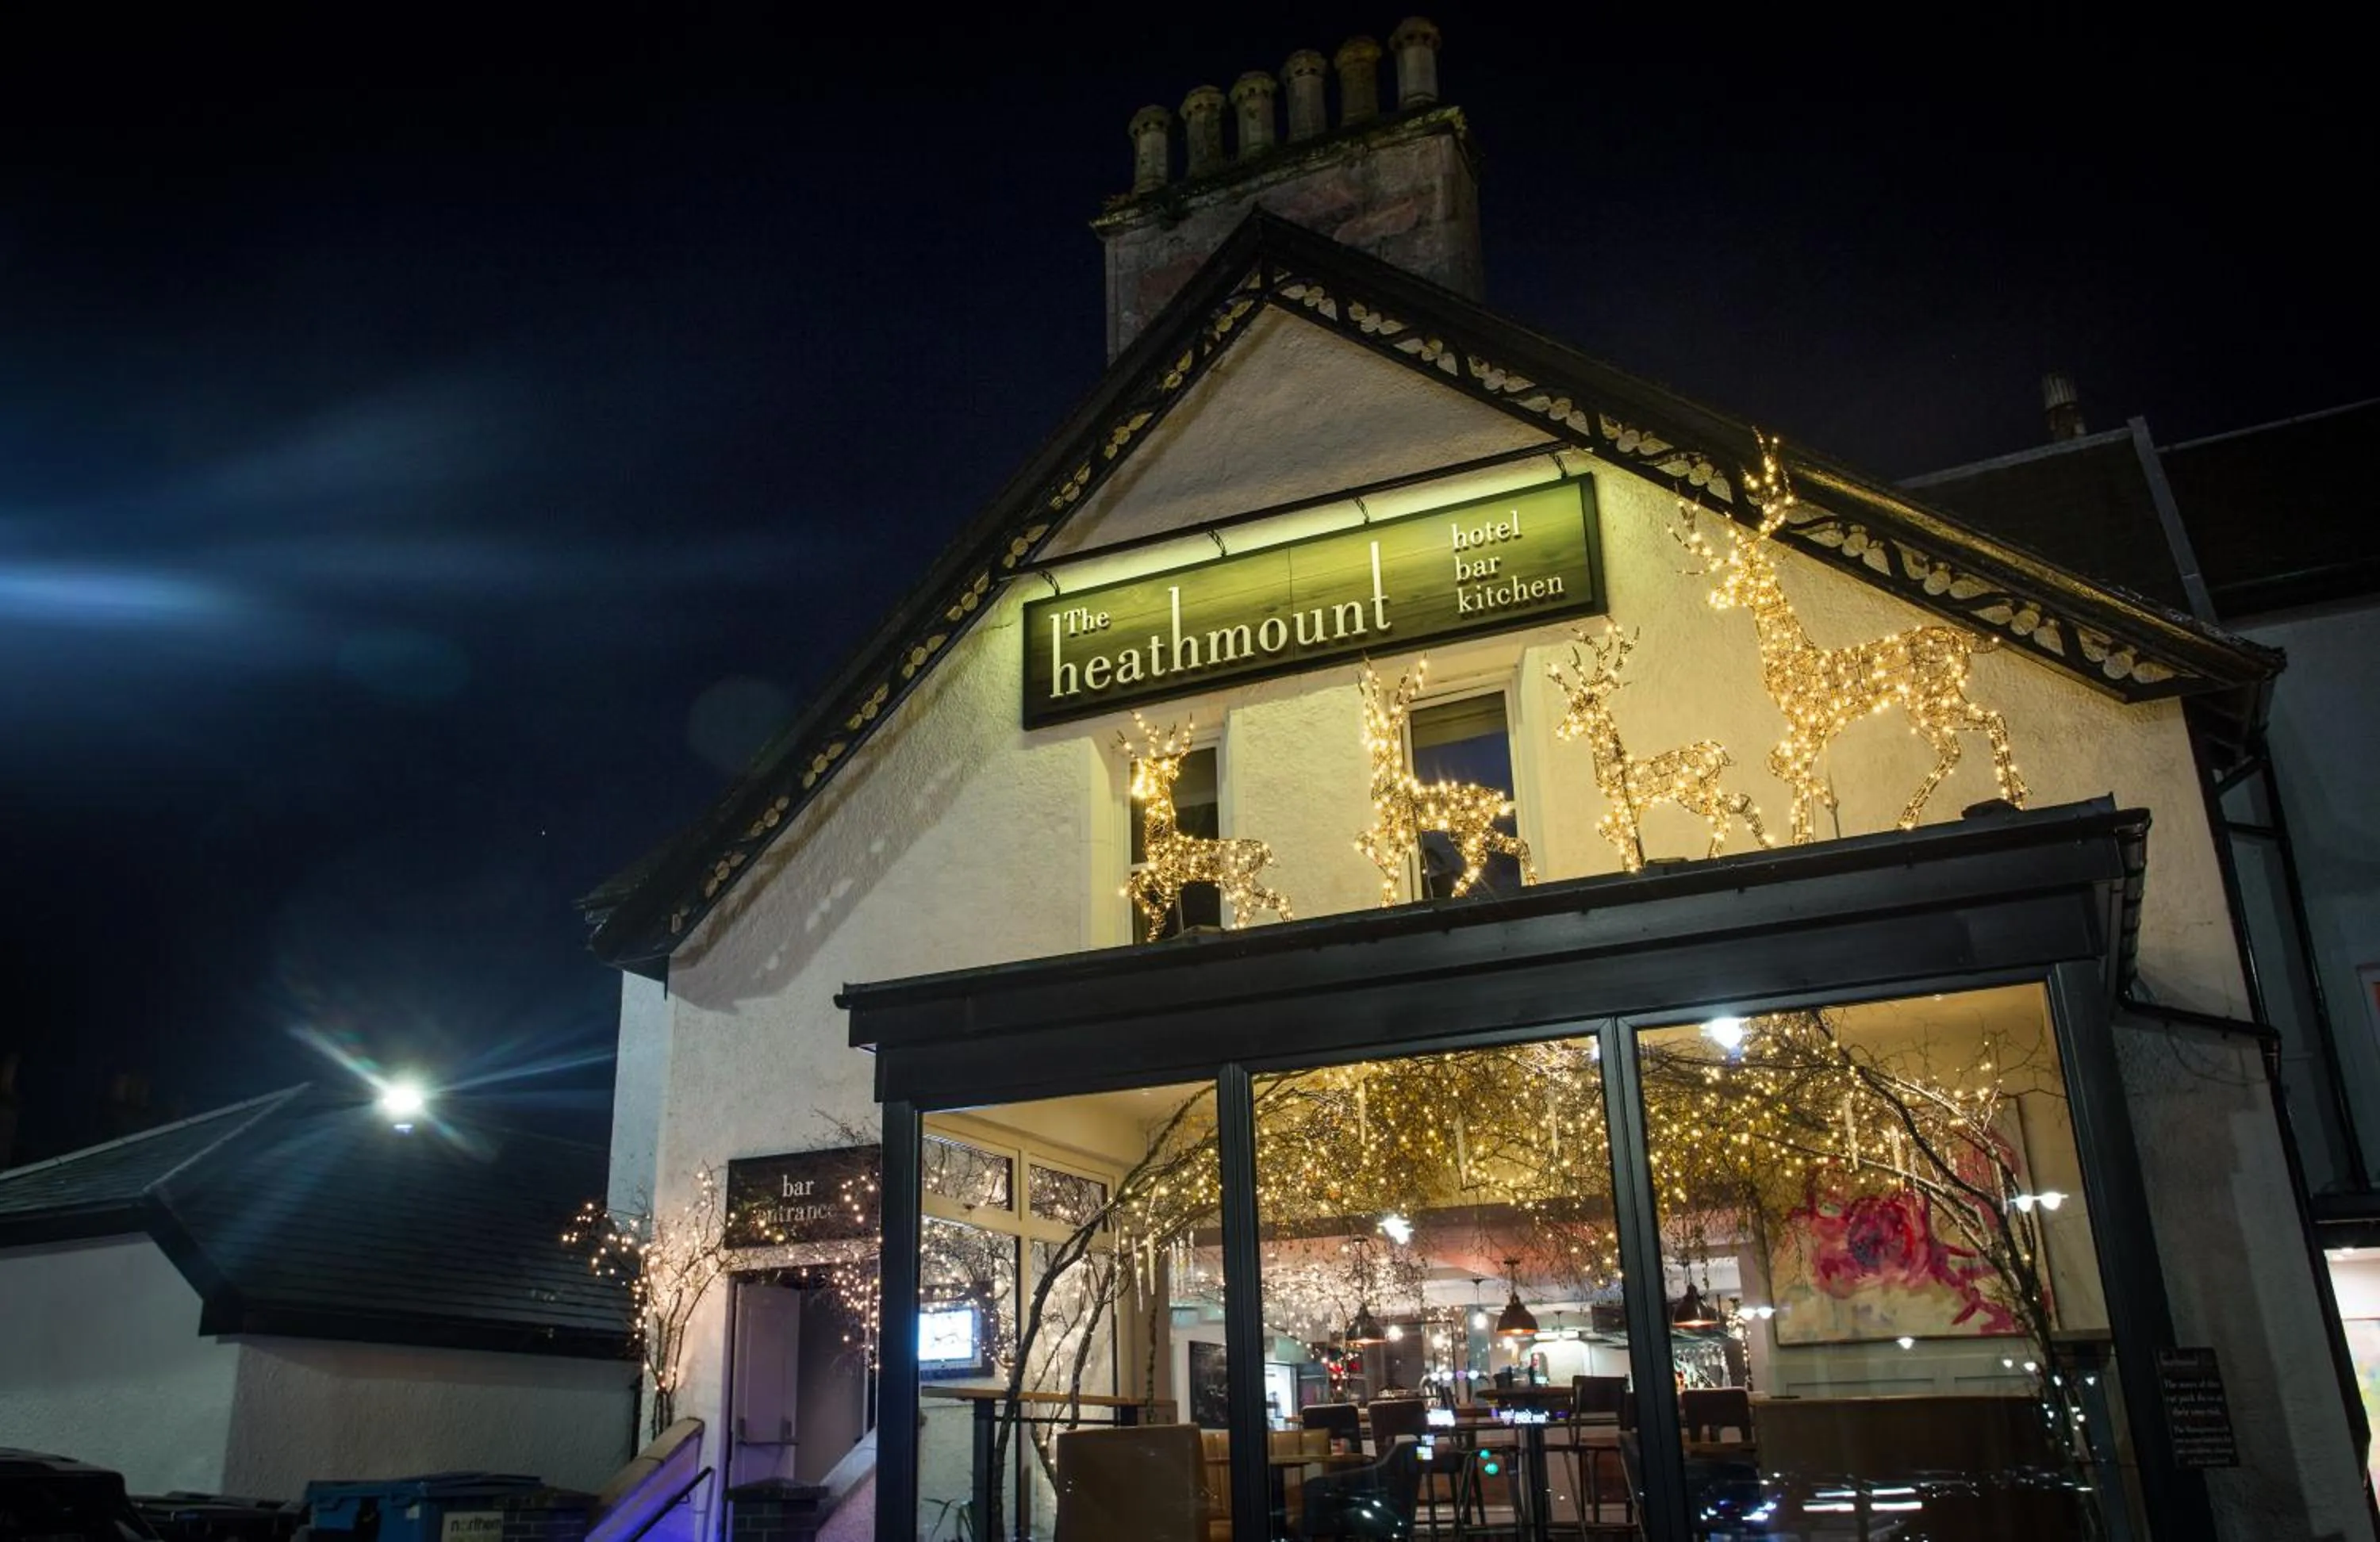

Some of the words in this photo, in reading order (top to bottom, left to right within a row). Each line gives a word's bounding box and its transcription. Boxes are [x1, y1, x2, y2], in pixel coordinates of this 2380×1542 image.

[1451, 512, 1522, 551] hotel
[1454, 554, 1500, 582] bar
[1457, 574, 1566, 614] kitchen
[1049, 541, 1392, 699] heathmount
[1064, 608, 1110, 636] The
[782, 1174, 815, 1197] bar
